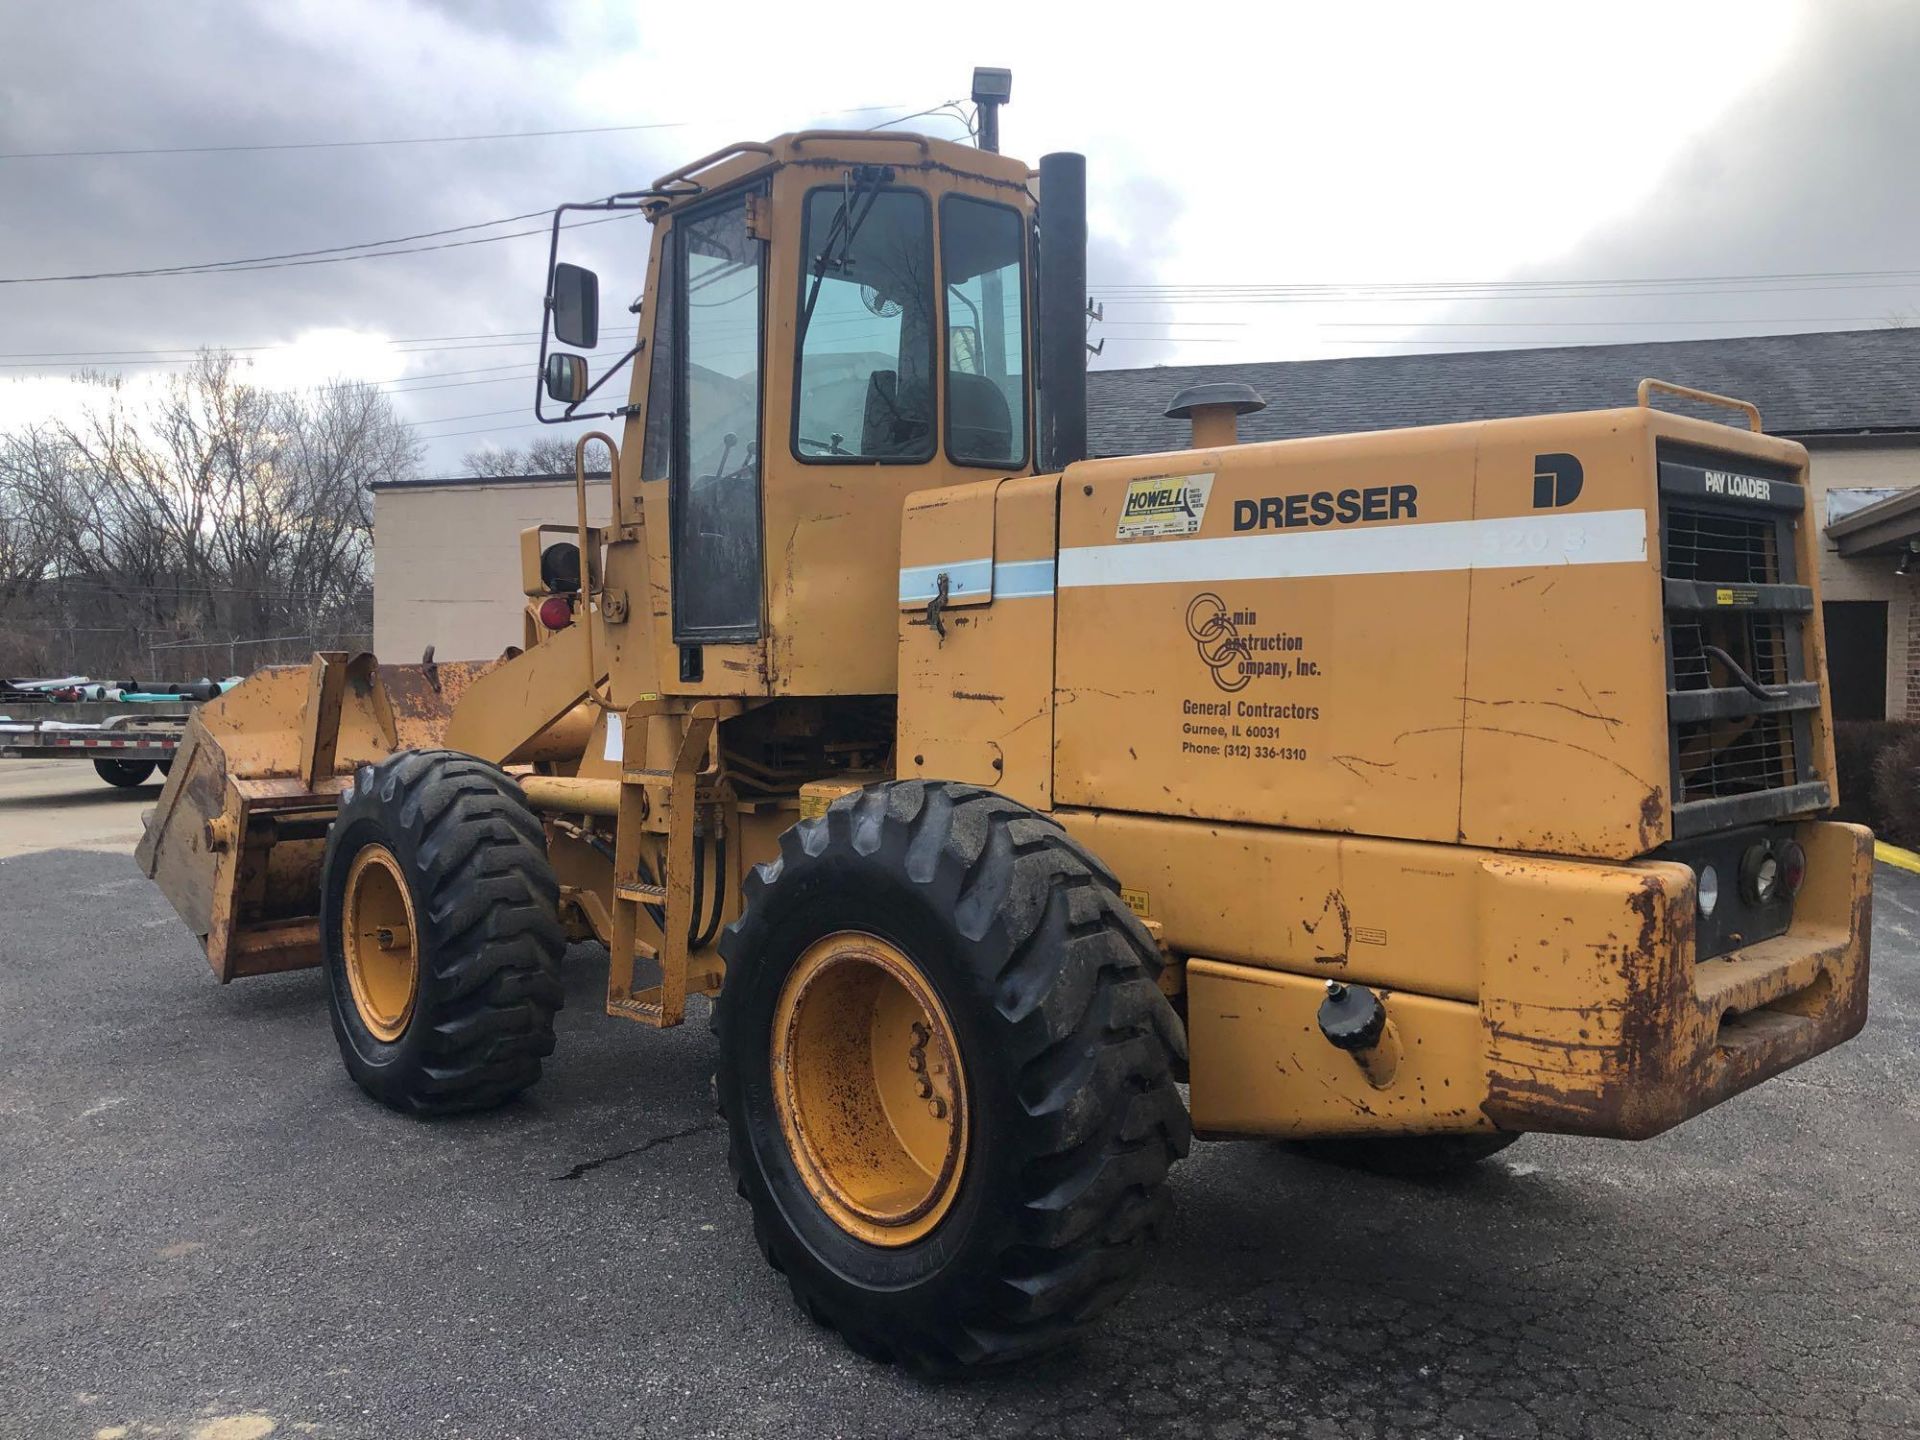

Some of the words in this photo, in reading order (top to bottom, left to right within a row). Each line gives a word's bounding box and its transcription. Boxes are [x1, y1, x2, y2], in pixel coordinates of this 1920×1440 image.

[1705, 471, 1726, 494] PAY
[1727, 475, 1771, 500] LOADER
[1125, 488, 1183, 516] HOWELL
[1233, 485, 1418, 531] DRESSER
[1296, 657, 1322, 676] Inc.
[1183, 699, 1231, 717] General
[1237, 701, 1319, 720] Contractors
[1182, 722, 1228, 739] Gurnee,
[1232, 725, 1242, 737] IL
[1245, 726, 1280, 739] 60031
[1182, 742, 1221, 755] Phone:
[1224, 744, 1251, 759] (312)
[1255, 746, 1307, 761] 336-1310
